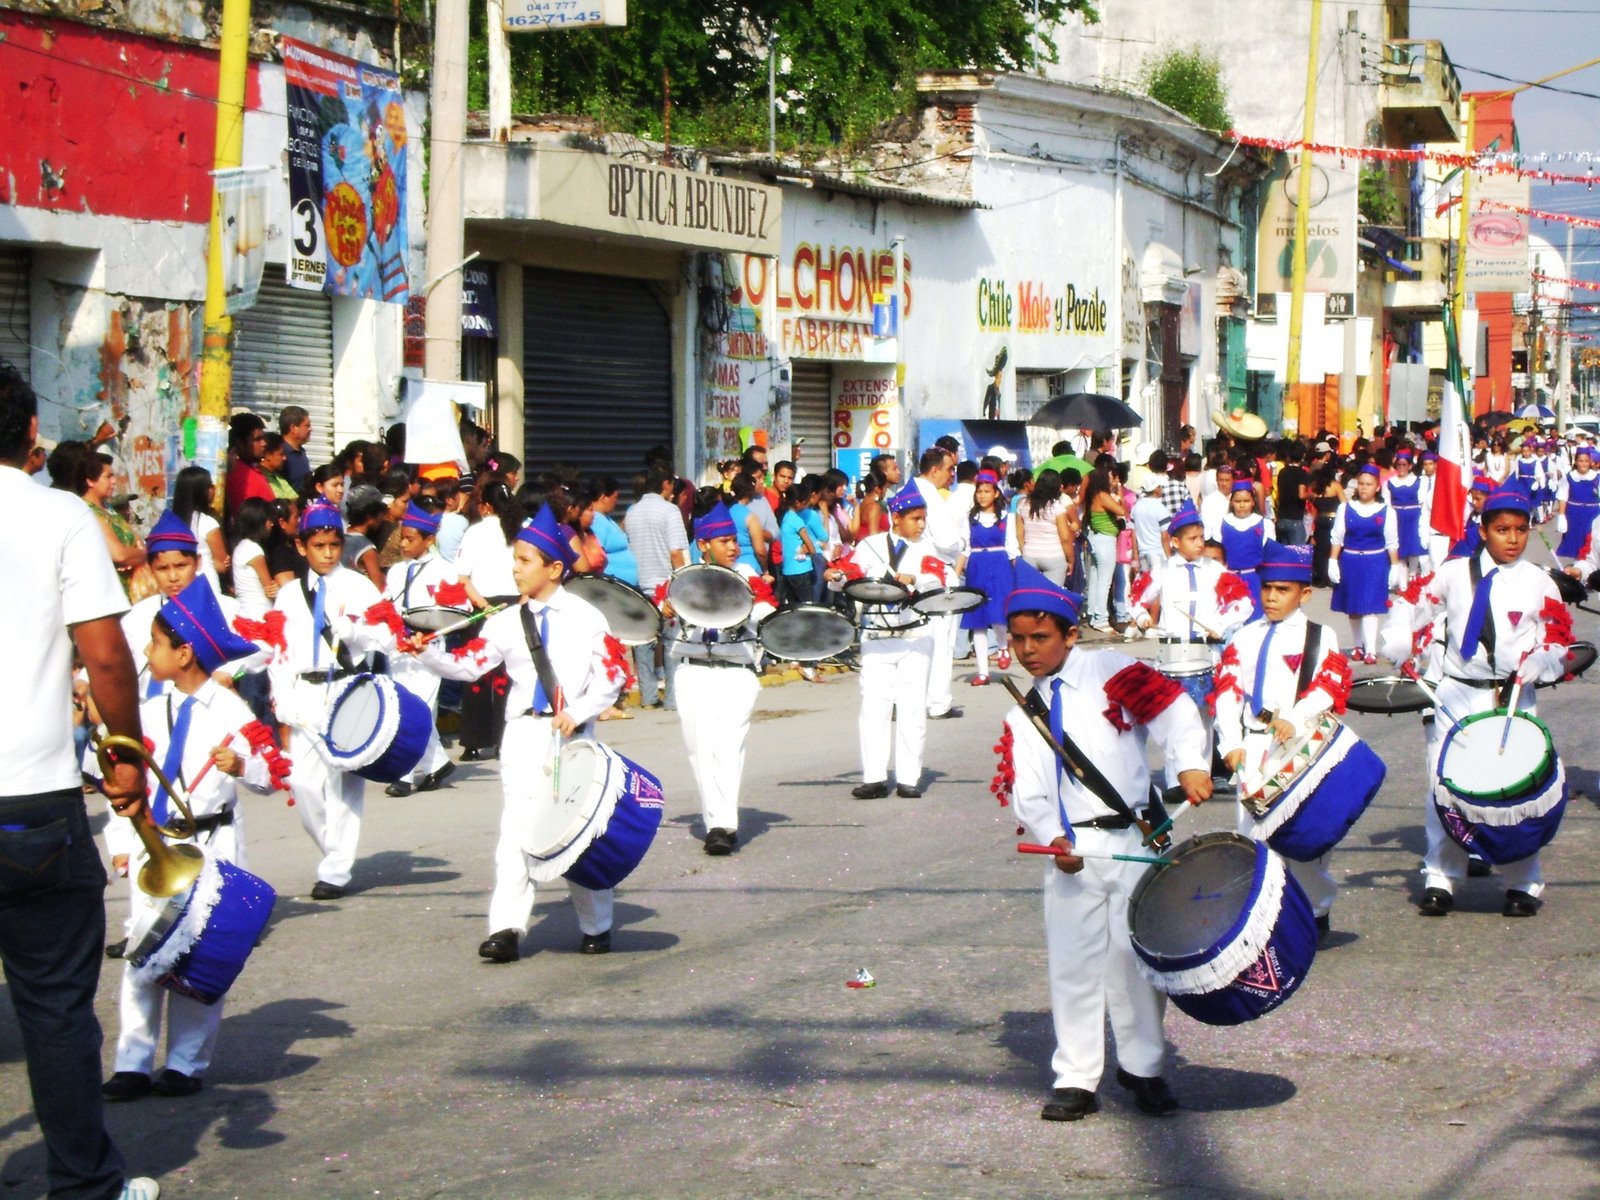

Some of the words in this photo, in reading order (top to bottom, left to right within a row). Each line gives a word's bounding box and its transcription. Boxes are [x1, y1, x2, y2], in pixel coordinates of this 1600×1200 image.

[527, 3, 550, 12] 044
[554, 1, 577, 10] 777
[507, 11, 601, 26] 162-71-45
[608, 163, 678, 227] OPTICA
[684, 176, 768, 240] ABUNDEZ
[294, 200, 318, 257] 3
[1275, 225, 1340, 237] moelos
[727, 242, 913, 320] OLCHONES
[978, 277, 1012, 330] Chile
[1018, 280, 1051, 332] Mole
[1055, 297, 1063, 332] y
[1066, 283, 1107, 335] Pozole
[843, 379, 896, 393] EXTENSO
[838, 393, 886, 407] SURTIDO
